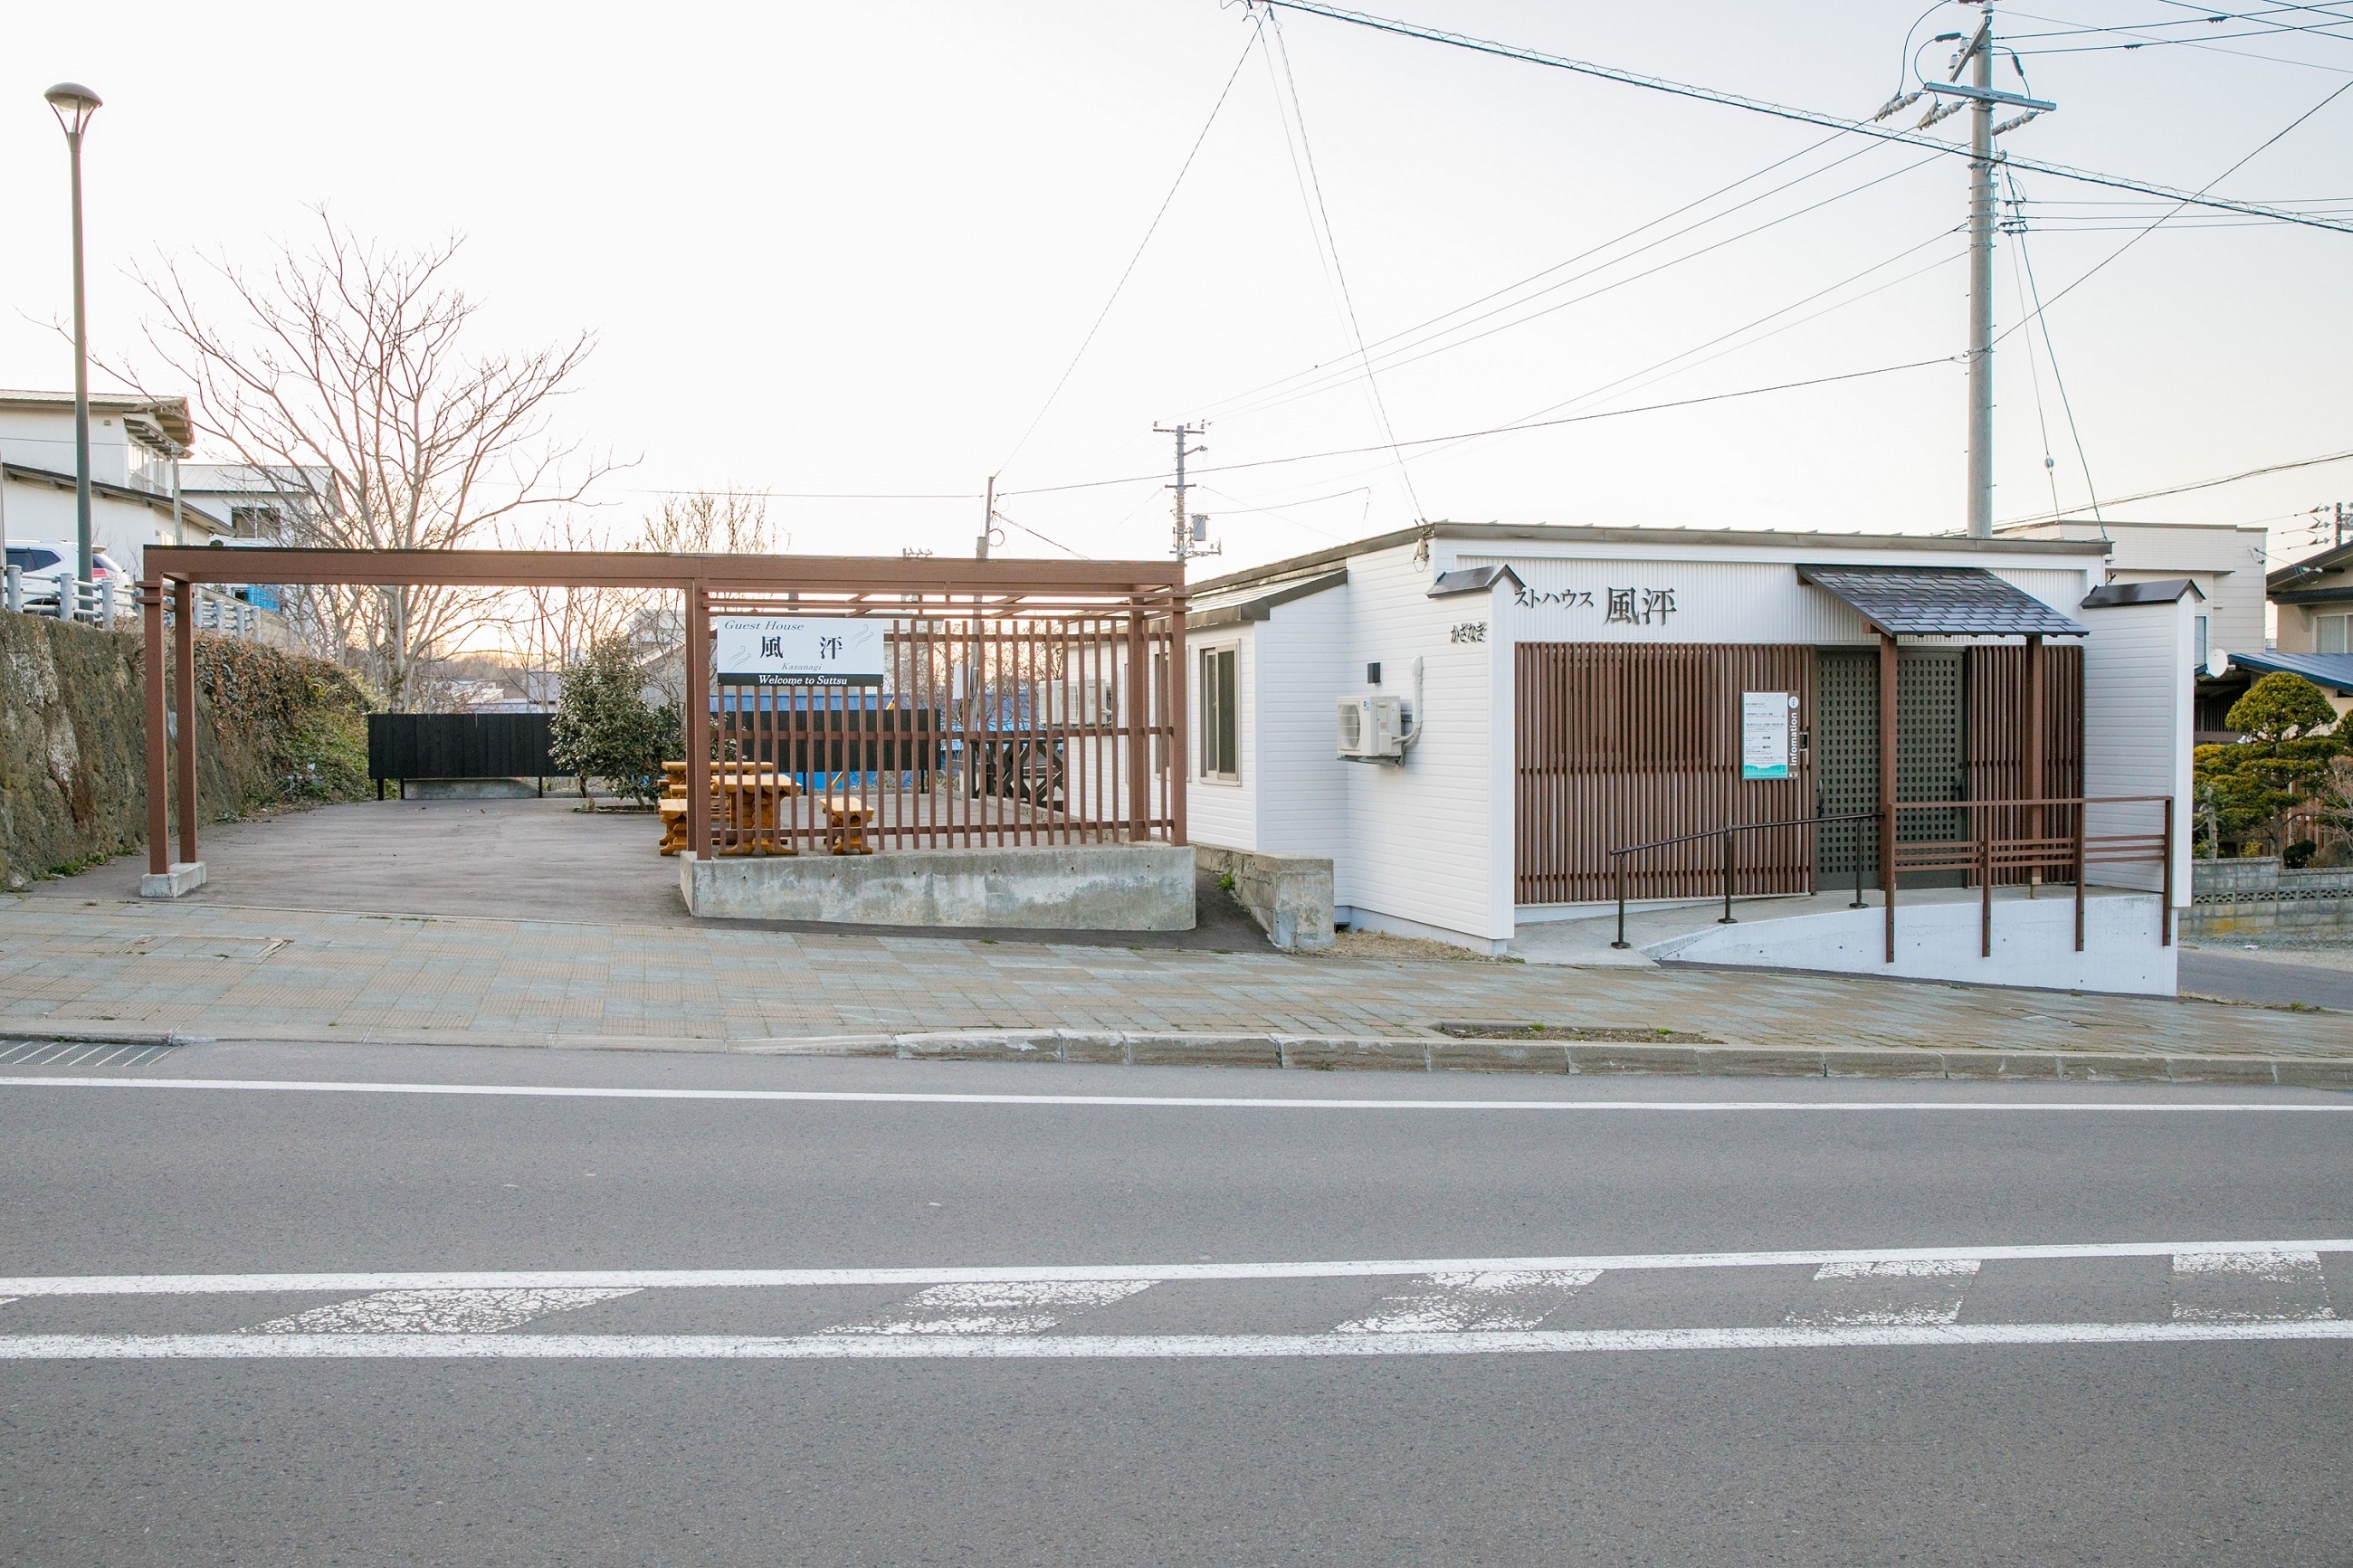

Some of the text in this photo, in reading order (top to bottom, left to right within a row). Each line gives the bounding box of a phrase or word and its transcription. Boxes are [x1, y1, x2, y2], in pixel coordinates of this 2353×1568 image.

[724, 620, 805, 631] Guest House
[1451, 622, 1486, 643] かざなぎ
[781, 662, 822, 672] Kazanagi
[758, 674, 848, 685] Welcome to Suttsu
